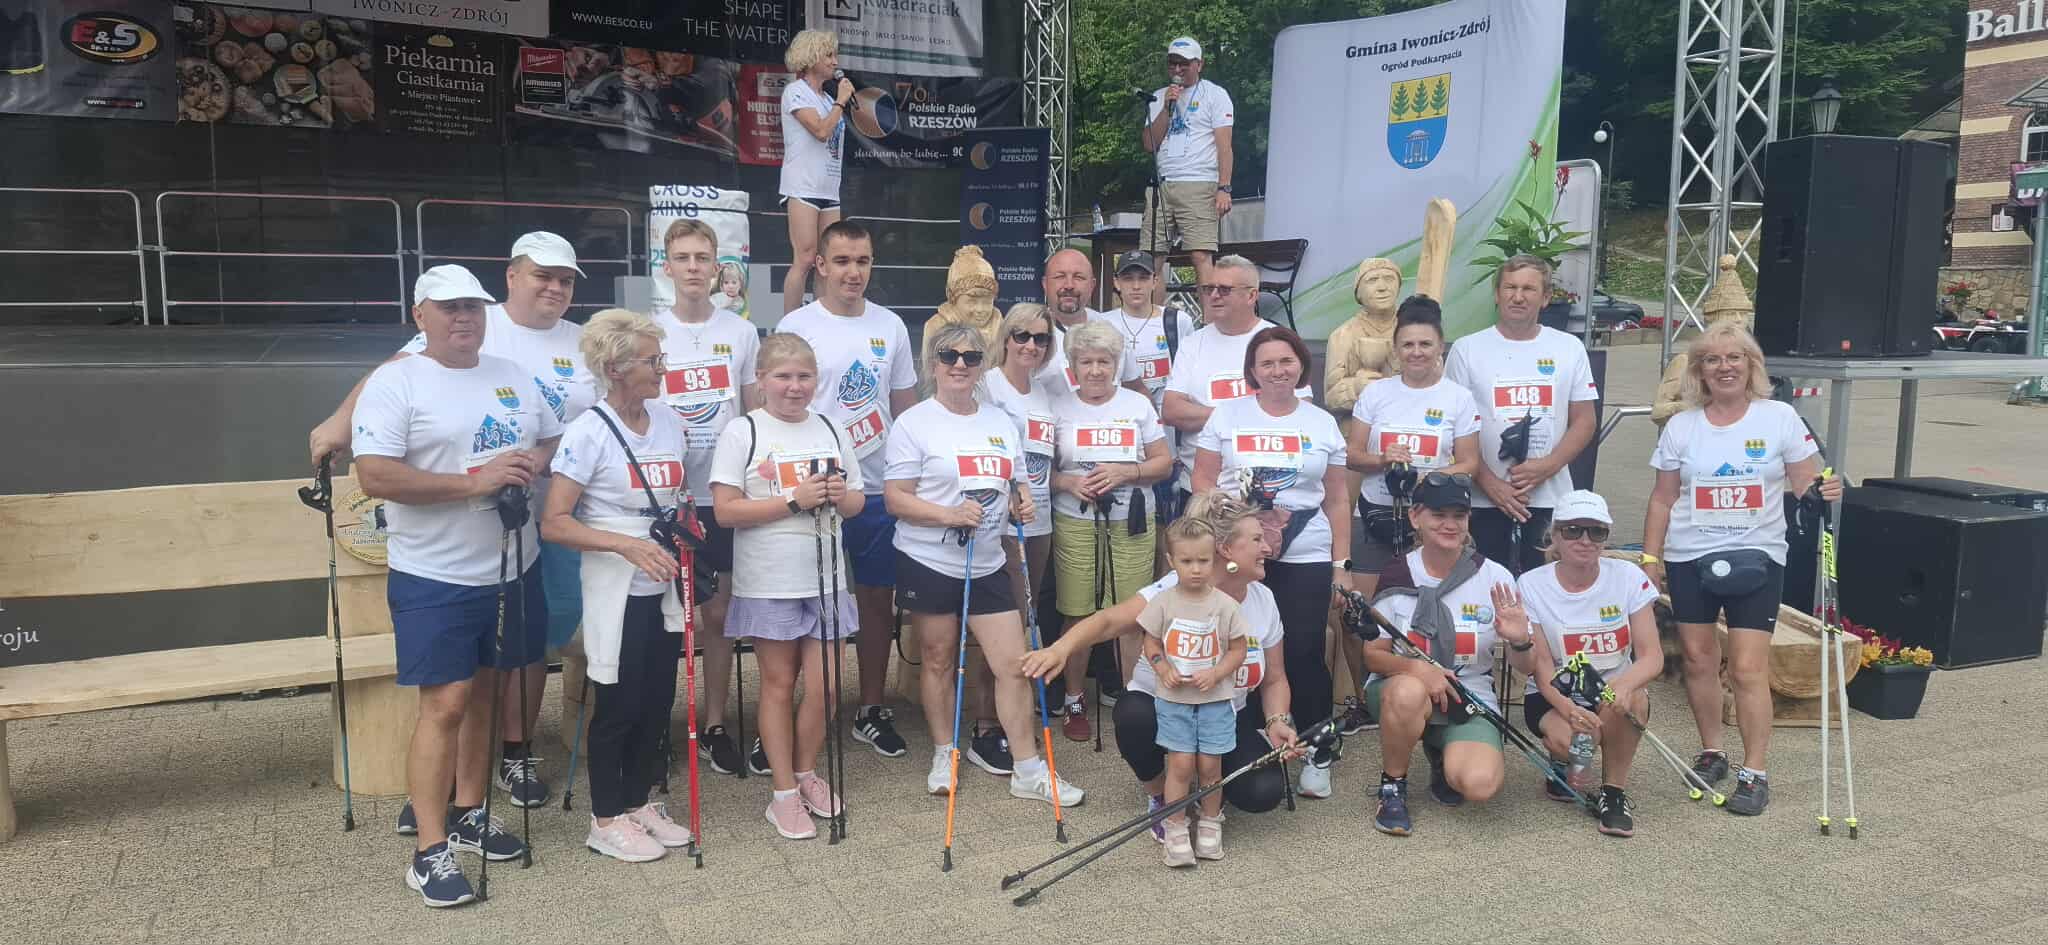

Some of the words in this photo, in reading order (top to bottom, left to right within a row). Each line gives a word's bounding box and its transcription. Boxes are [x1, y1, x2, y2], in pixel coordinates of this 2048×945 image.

[571, 12, 653, 30] WWW.BESCO.EU
[724, 0, 783, 21] SHAPE
[1966, 0, 2048, 42] Ball
[683, 18, 721, 37] THE
[725, 23, 789, 44] WATER
[1346, 41, 1397, 59] Gmina
[1401, 16, 1492, 51] Iwonicz-Zdrój
[384, 44, 496, 76] Piekarnia
[1381, 59, 1409, 72] Ogród
[1411, 50, 1462, 67] Podkarpacia
[396, 71, 485, 92] Ciastkarnia
[909, 102, 945, 113] Polskie
[947, 103, 976, 114] Radio
[908, 113, 977, 129] RZESZÓW
[683, 369, 711, 391] 93
[1507, 386, 1540, 405] 148
[1089, 429, 1122, 446] 196
[1252, 436, 1283, 451] 176
[640, 463, 671, 487] 181
[972, 456, 1001, 476] 147
[1708, 487, 1748, 509] 182
[0, 626, 40, 652] oju
[1177, 631, 1213, 658] 520
[1579, 633, 1618, 654] 213
[1234, 665, 1249, 687] 9
